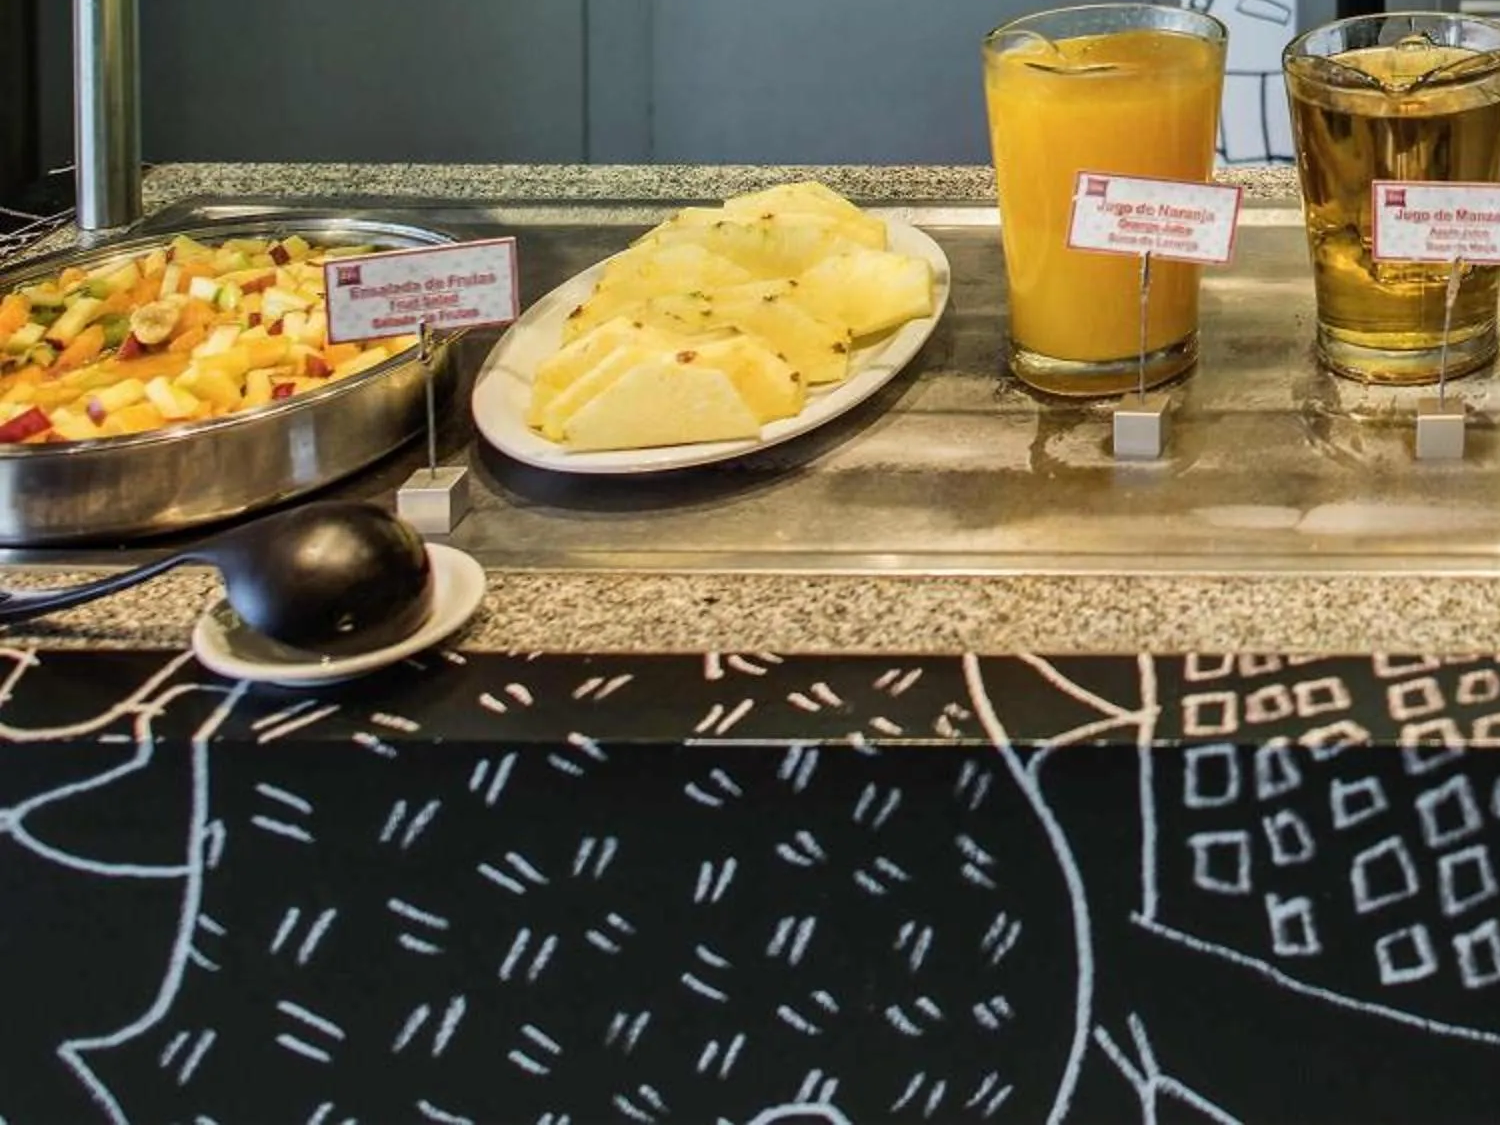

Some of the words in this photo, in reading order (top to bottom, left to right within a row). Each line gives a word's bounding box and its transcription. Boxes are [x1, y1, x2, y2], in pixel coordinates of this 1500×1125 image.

[1097, 200, 1134, 216] Jugo
[1135, 202, 1156, 216] de
[1158, 203, 1216, 224] Naranja
[1394, 209, 1431, 224] Jugo
[1433, 209, 1454, 222] de
[350, 280, 422, 301] Ensalada
[424, 277, 445, 291] de
[447, 272, 497, 289] Frutas
